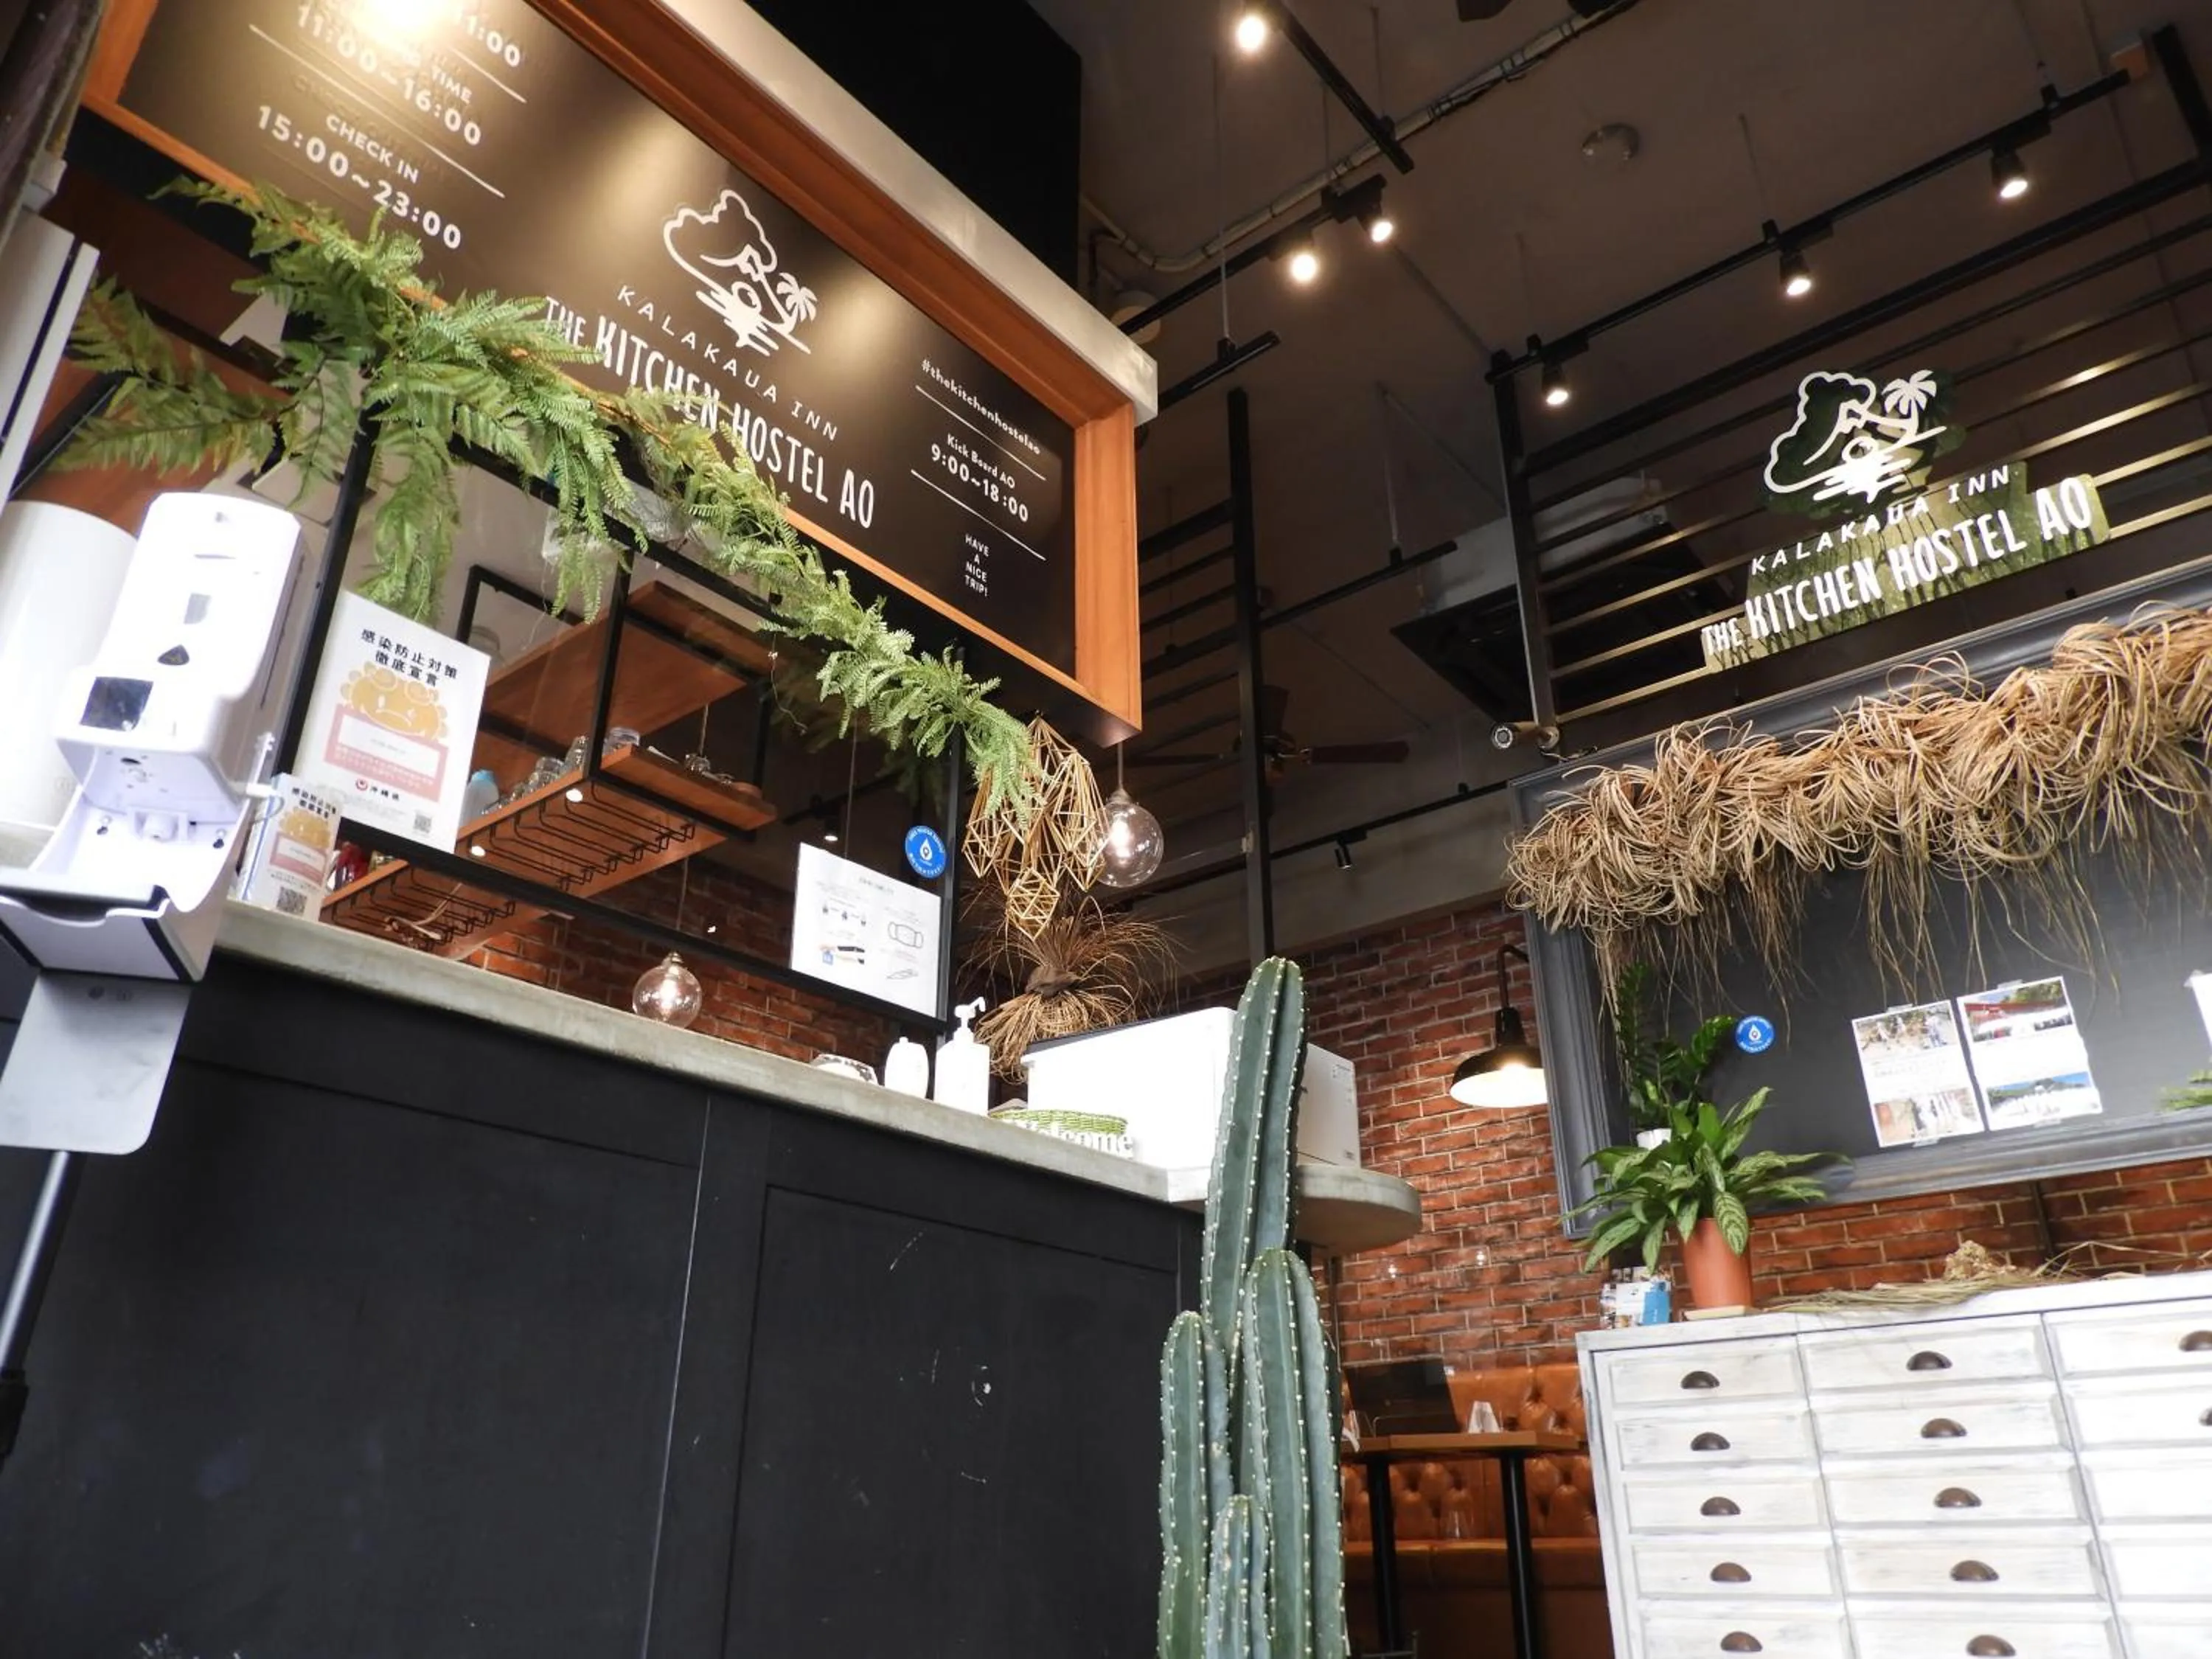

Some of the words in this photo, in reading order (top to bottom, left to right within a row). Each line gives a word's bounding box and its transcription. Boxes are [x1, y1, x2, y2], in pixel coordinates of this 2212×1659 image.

[454, 4, 521, 68] 1:00
[258, 105, 462, 249] 15:00~23:00
[326, 114, 392, 168] CHECK
[397, 158, 420, 184] IN
[616, 284, 778, 404] KALAKAUA
[790, 400, 838, 442] INN
[594, 314, 720, 434] KITCHEN
[731, 402, 829, 504] HOSTEL
[839, 469, 875, 529] AO
[947, 433, 970, 458] Kick
[970, 449, 998, 478] Board
[998, 471, 1016, 490] AO
[964, 533, 990, 557] HAVE
[1750, 494, 1930, 576] KALAKAUA
[1946, 465, 2011, 504] INN
[964, 560, 988, 583] NICE
[964, 574, 989, 597] TRIP!
[973, 553, 981, 566] A
[1700, 616, 1747, 656] THE
[1743, 555, 1884, 641] KITCHEN
[1887, 509, 2028, 591] HOSTEL
[2034, 476, 2094, 543] AO
